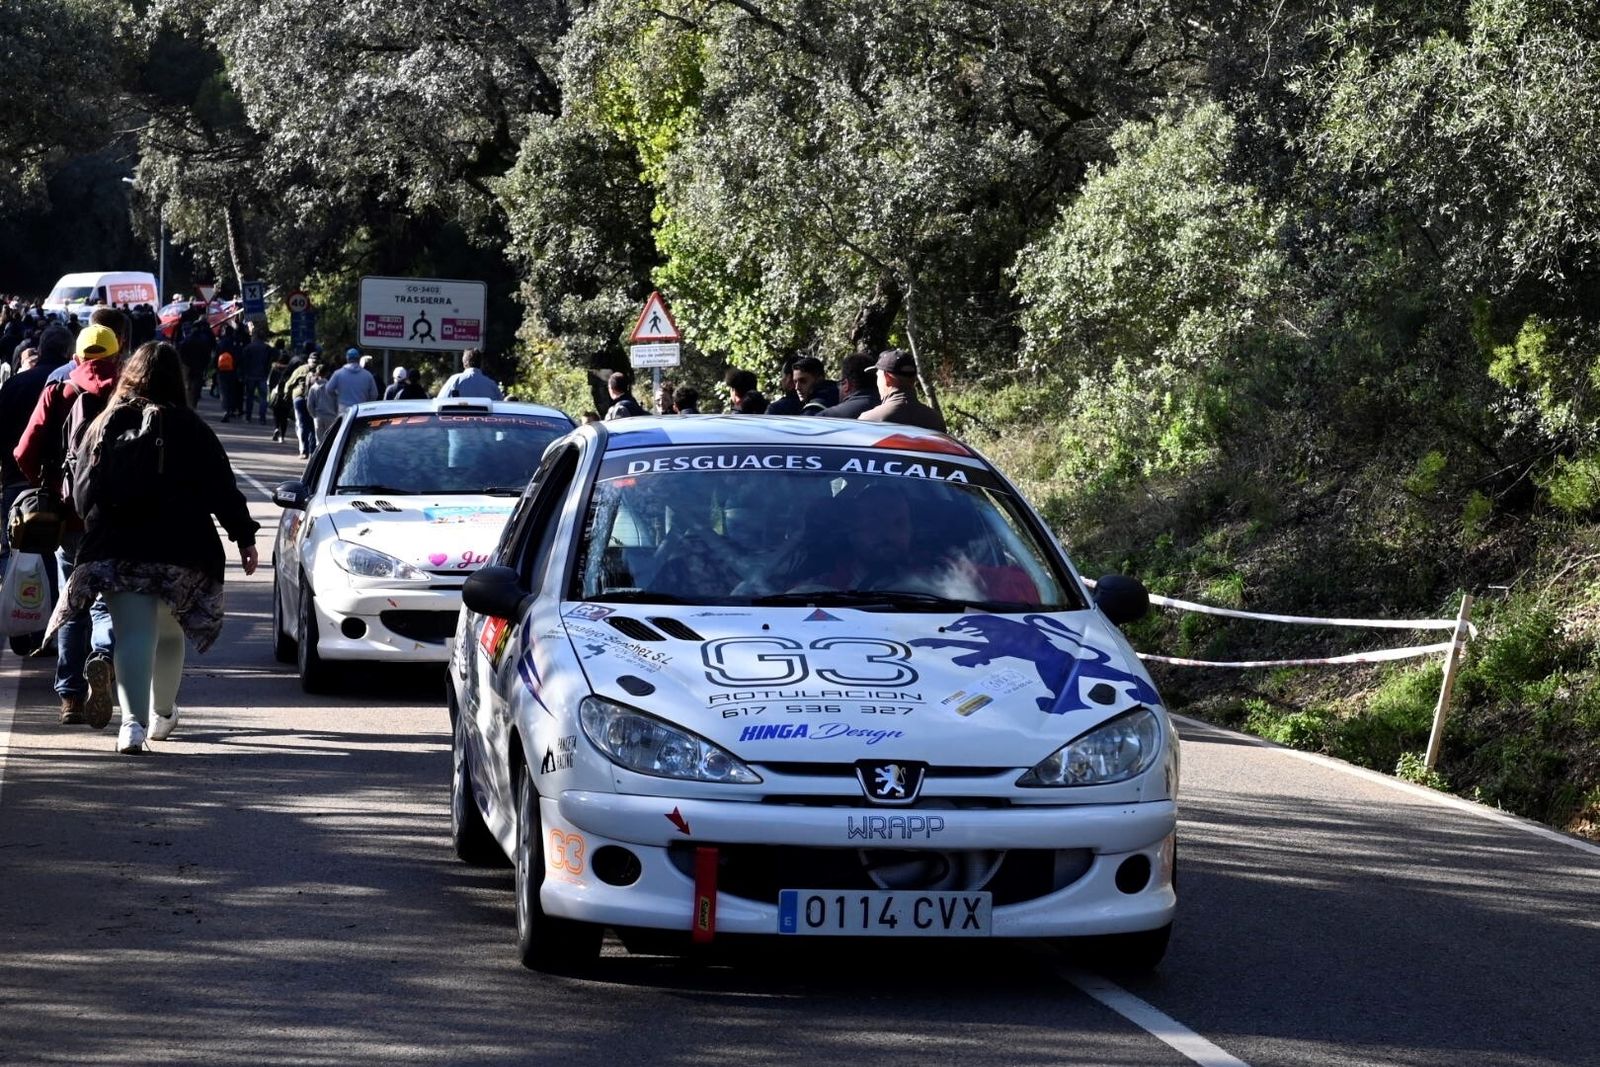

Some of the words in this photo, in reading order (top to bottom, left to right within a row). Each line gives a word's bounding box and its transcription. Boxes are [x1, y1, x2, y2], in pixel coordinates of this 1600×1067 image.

[291, 298, 305, 307] 40
[395, 295, 452, 305] TRASSIERRA
[627, 454, 823, 475] DESGUACES
[840, 457, 969, 483] ALCALA
[701, 636, 919, 687] G3
[709, 690, 922, 704] ROTULACION
[722, 706, 767, 719] 617
[786, 704, 841, 714] 536
[861, 705, 913, 716] 327
[739, 724, 808, 742] HINGA
[809, 723, 904, 745] Design
[847, 815, 945, 839] WRAPP
[549, 828, 585, 876] G3
[784, 916, 792, 925] E
[805, 895, 897, 929] 0114
[913, 897, 981, 929] CVX
